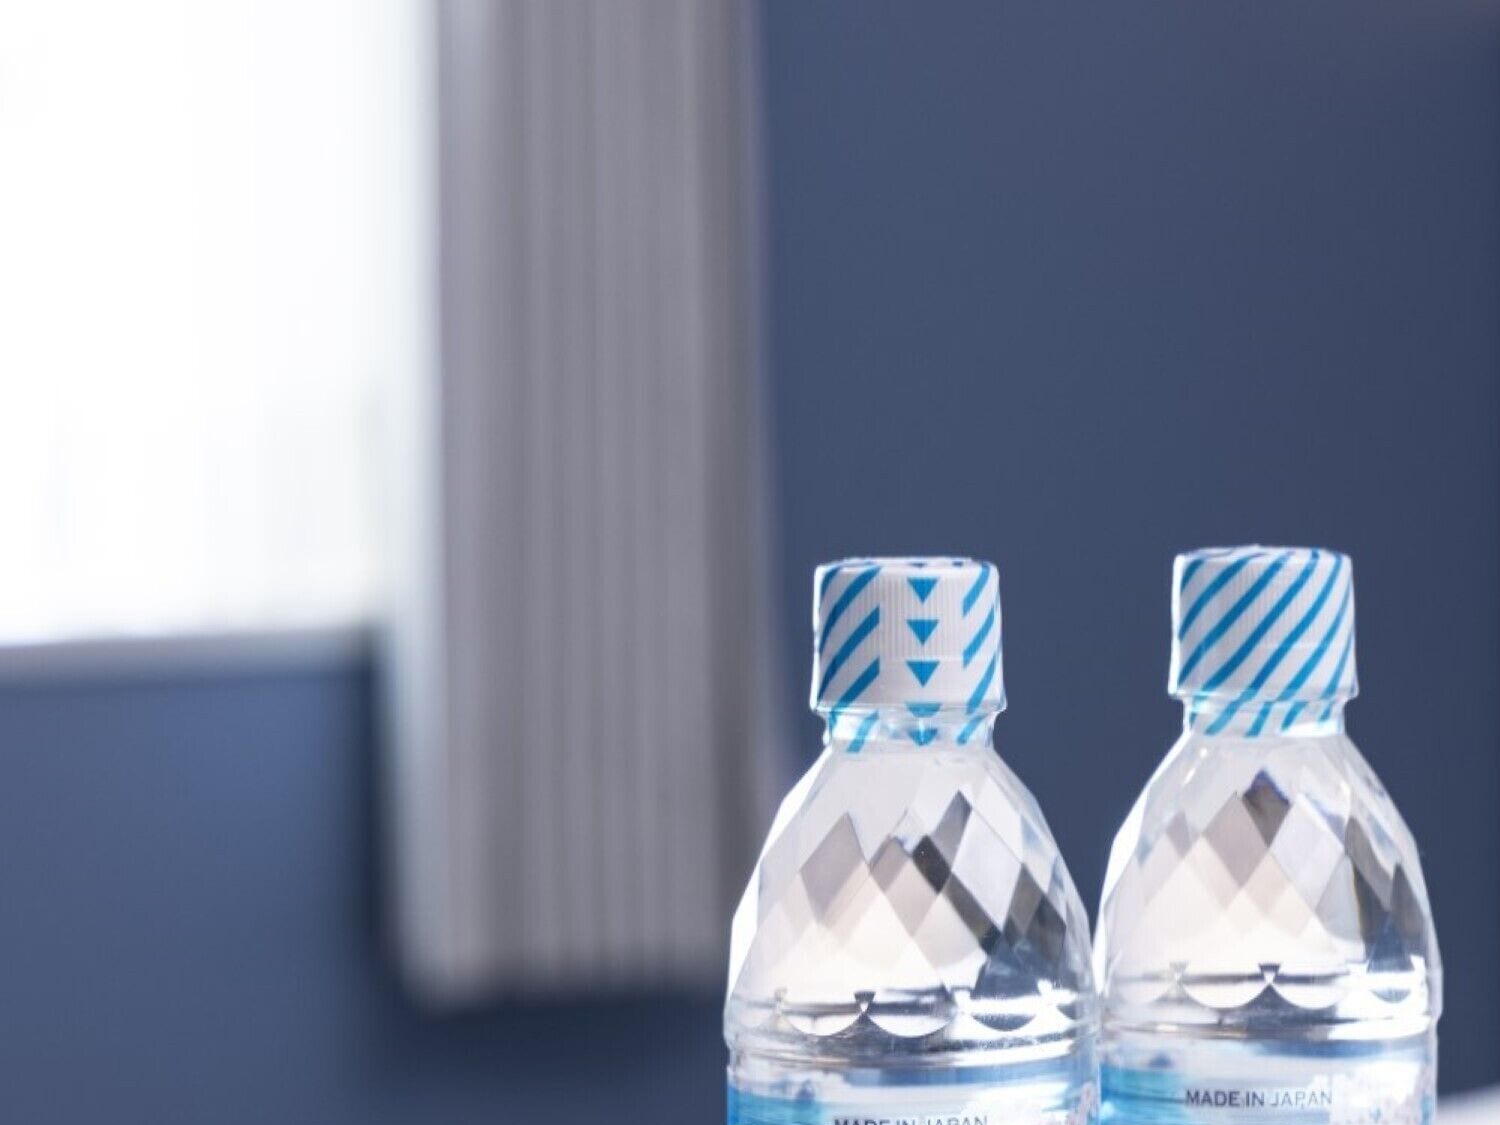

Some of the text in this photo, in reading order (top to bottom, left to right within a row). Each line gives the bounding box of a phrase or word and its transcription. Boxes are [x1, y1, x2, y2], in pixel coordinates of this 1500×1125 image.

[1185, 1089, 1333, 1108] MADE IN JAPAN
